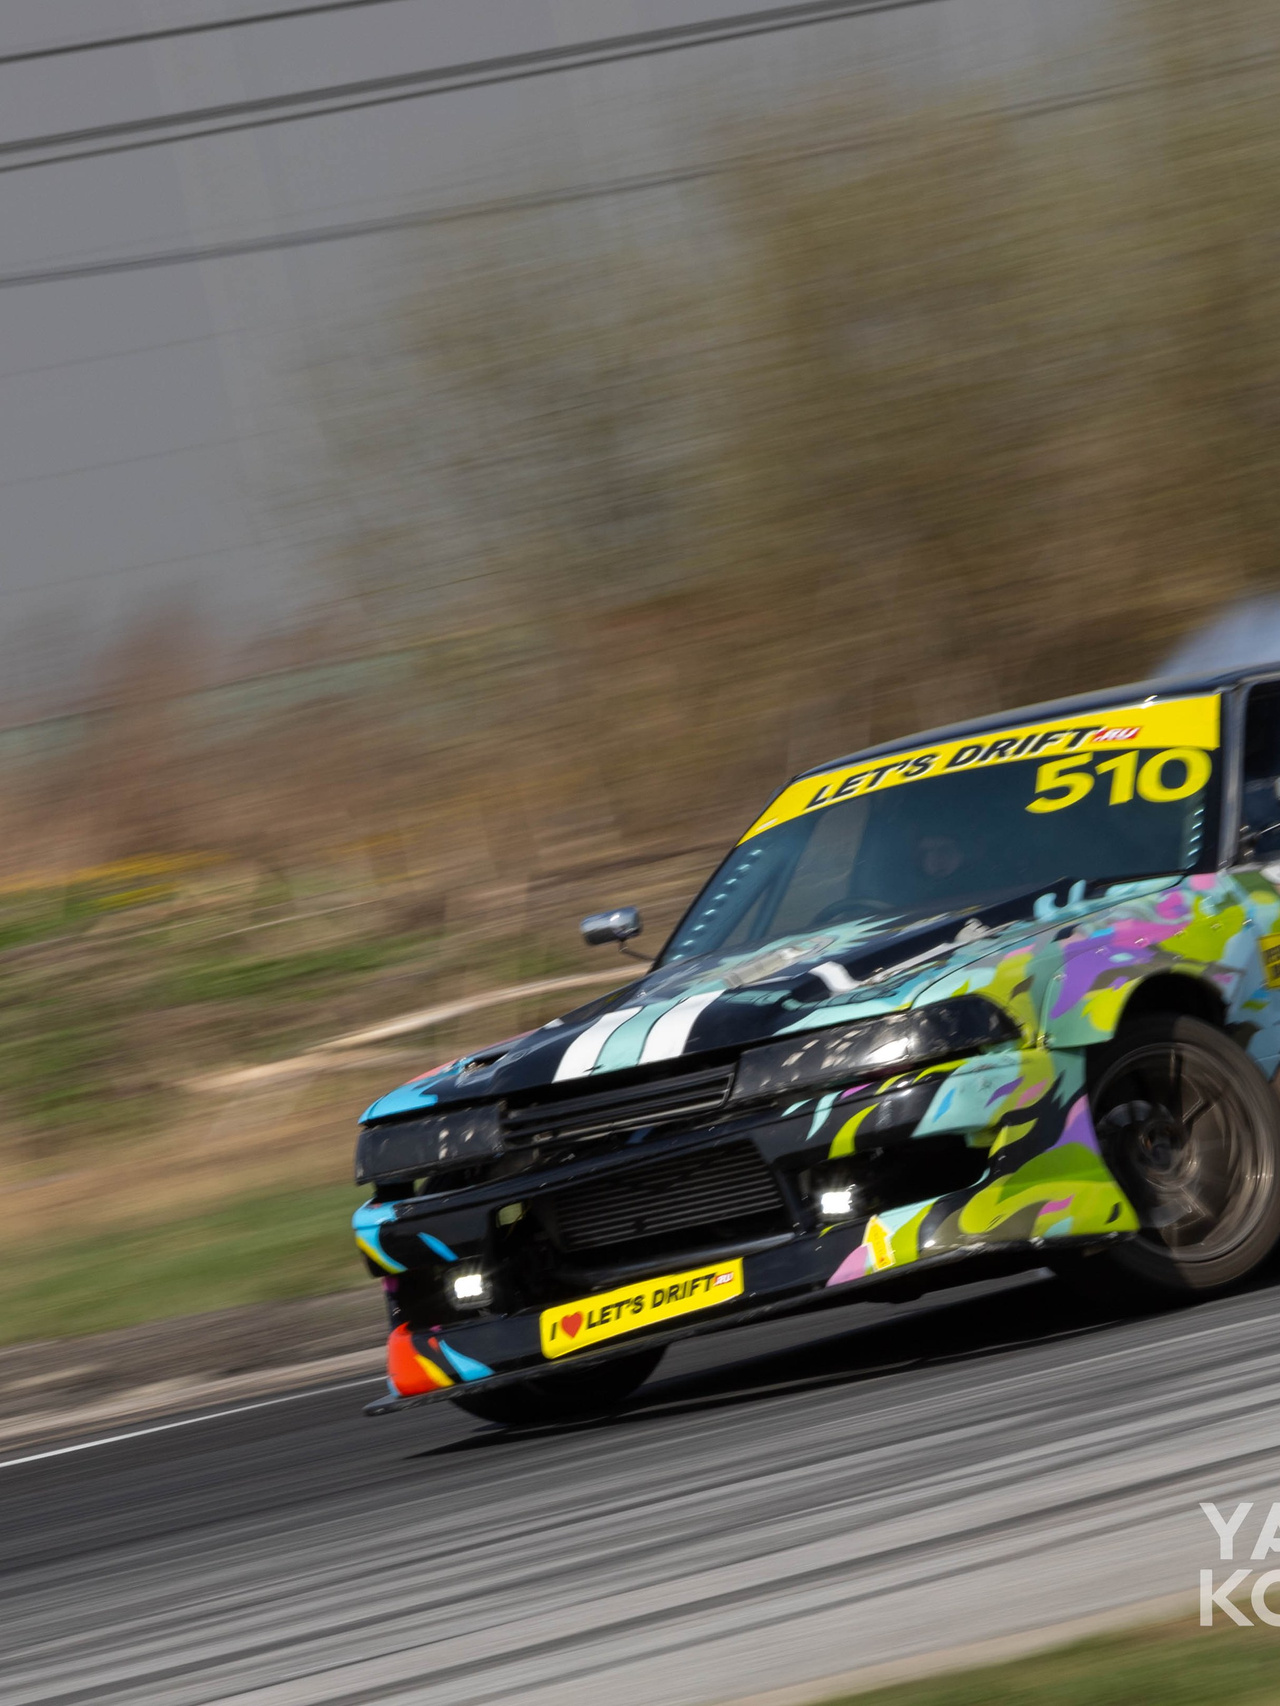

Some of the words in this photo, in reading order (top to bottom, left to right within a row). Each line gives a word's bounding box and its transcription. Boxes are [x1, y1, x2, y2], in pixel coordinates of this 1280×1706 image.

[803, 753, 940, 809] LET'S
[1024, 746, 1213, 814] 510
[550, 1321, 558, 1341] I
[586, 1295, 646, 1330] LET'S
